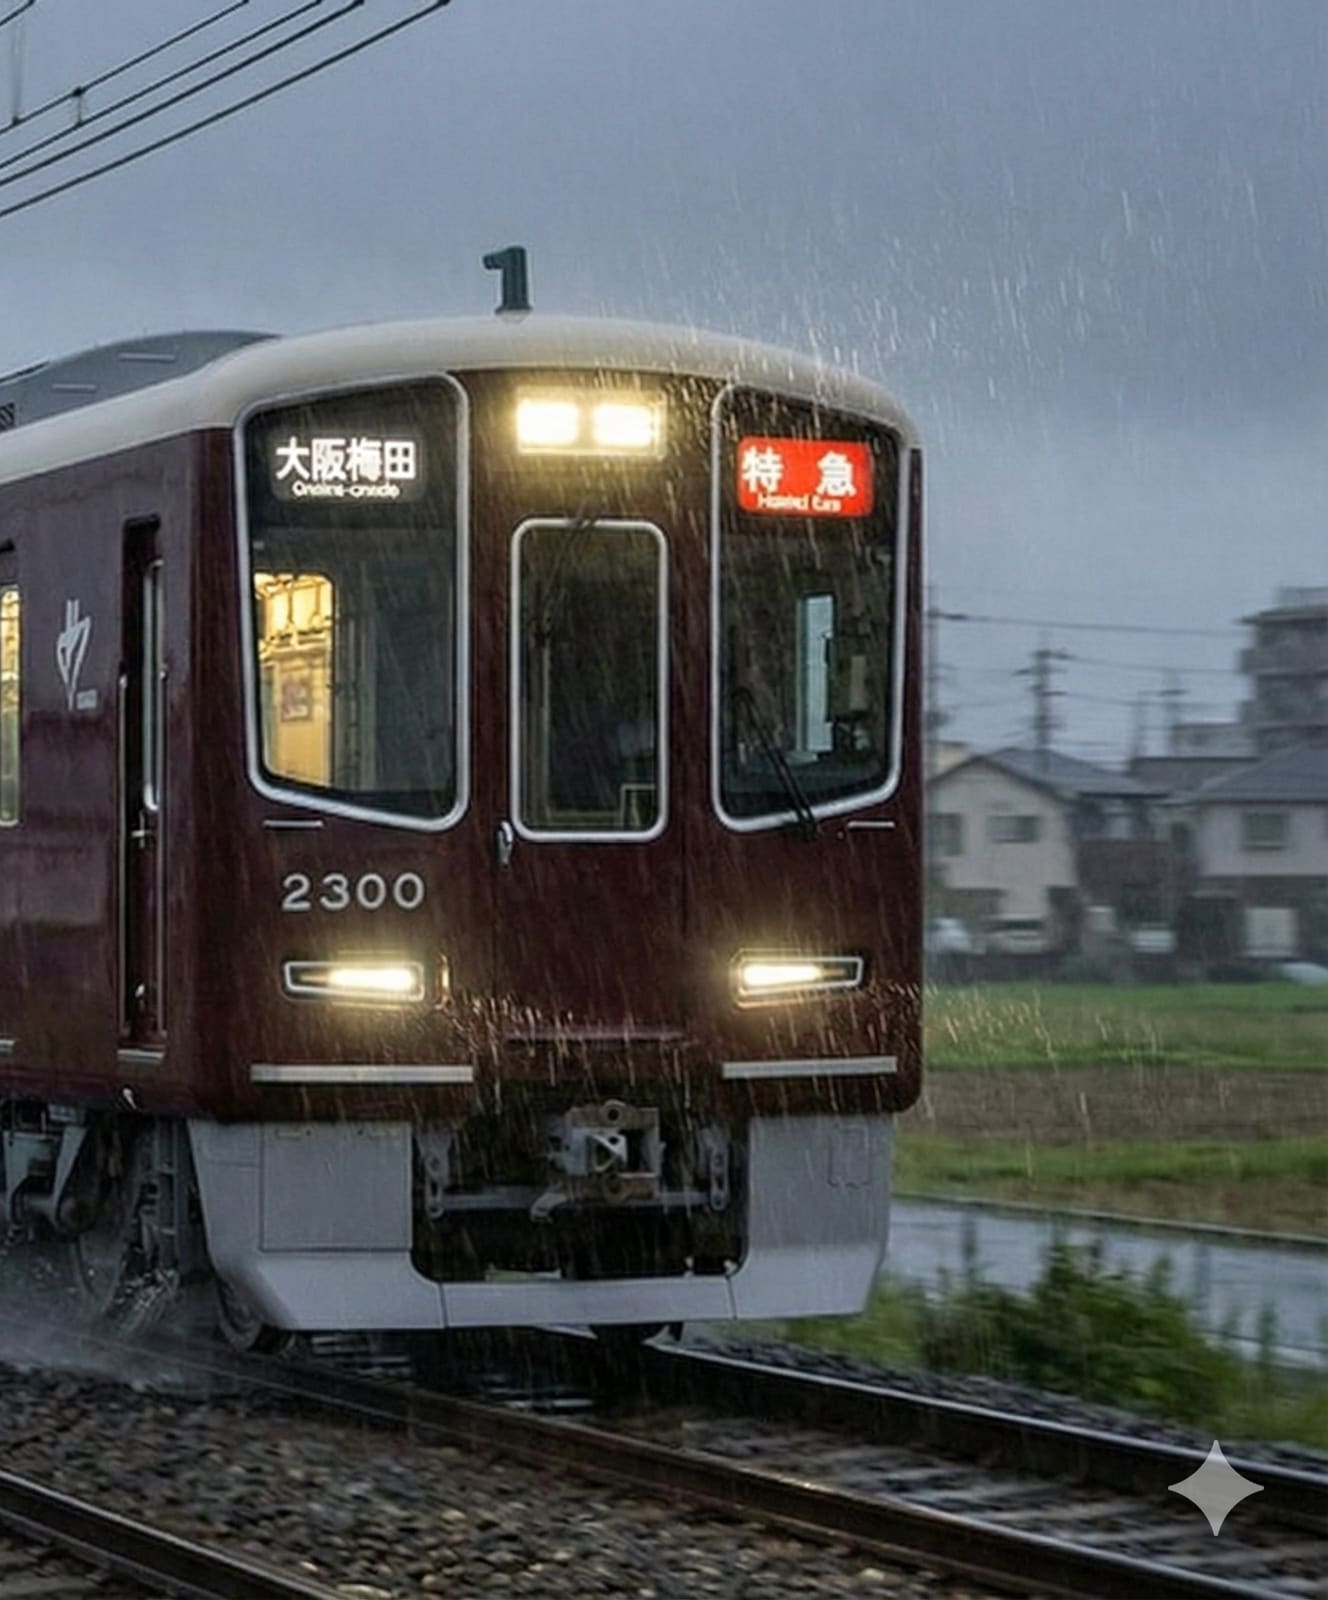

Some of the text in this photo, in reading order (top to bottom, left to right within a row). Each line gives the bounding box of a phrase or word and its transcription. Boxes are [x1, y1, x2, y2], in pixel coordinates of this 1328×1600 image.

[275, 436, 416, 481] 大阪梅田
[282, 873, 425, 911] 2300
